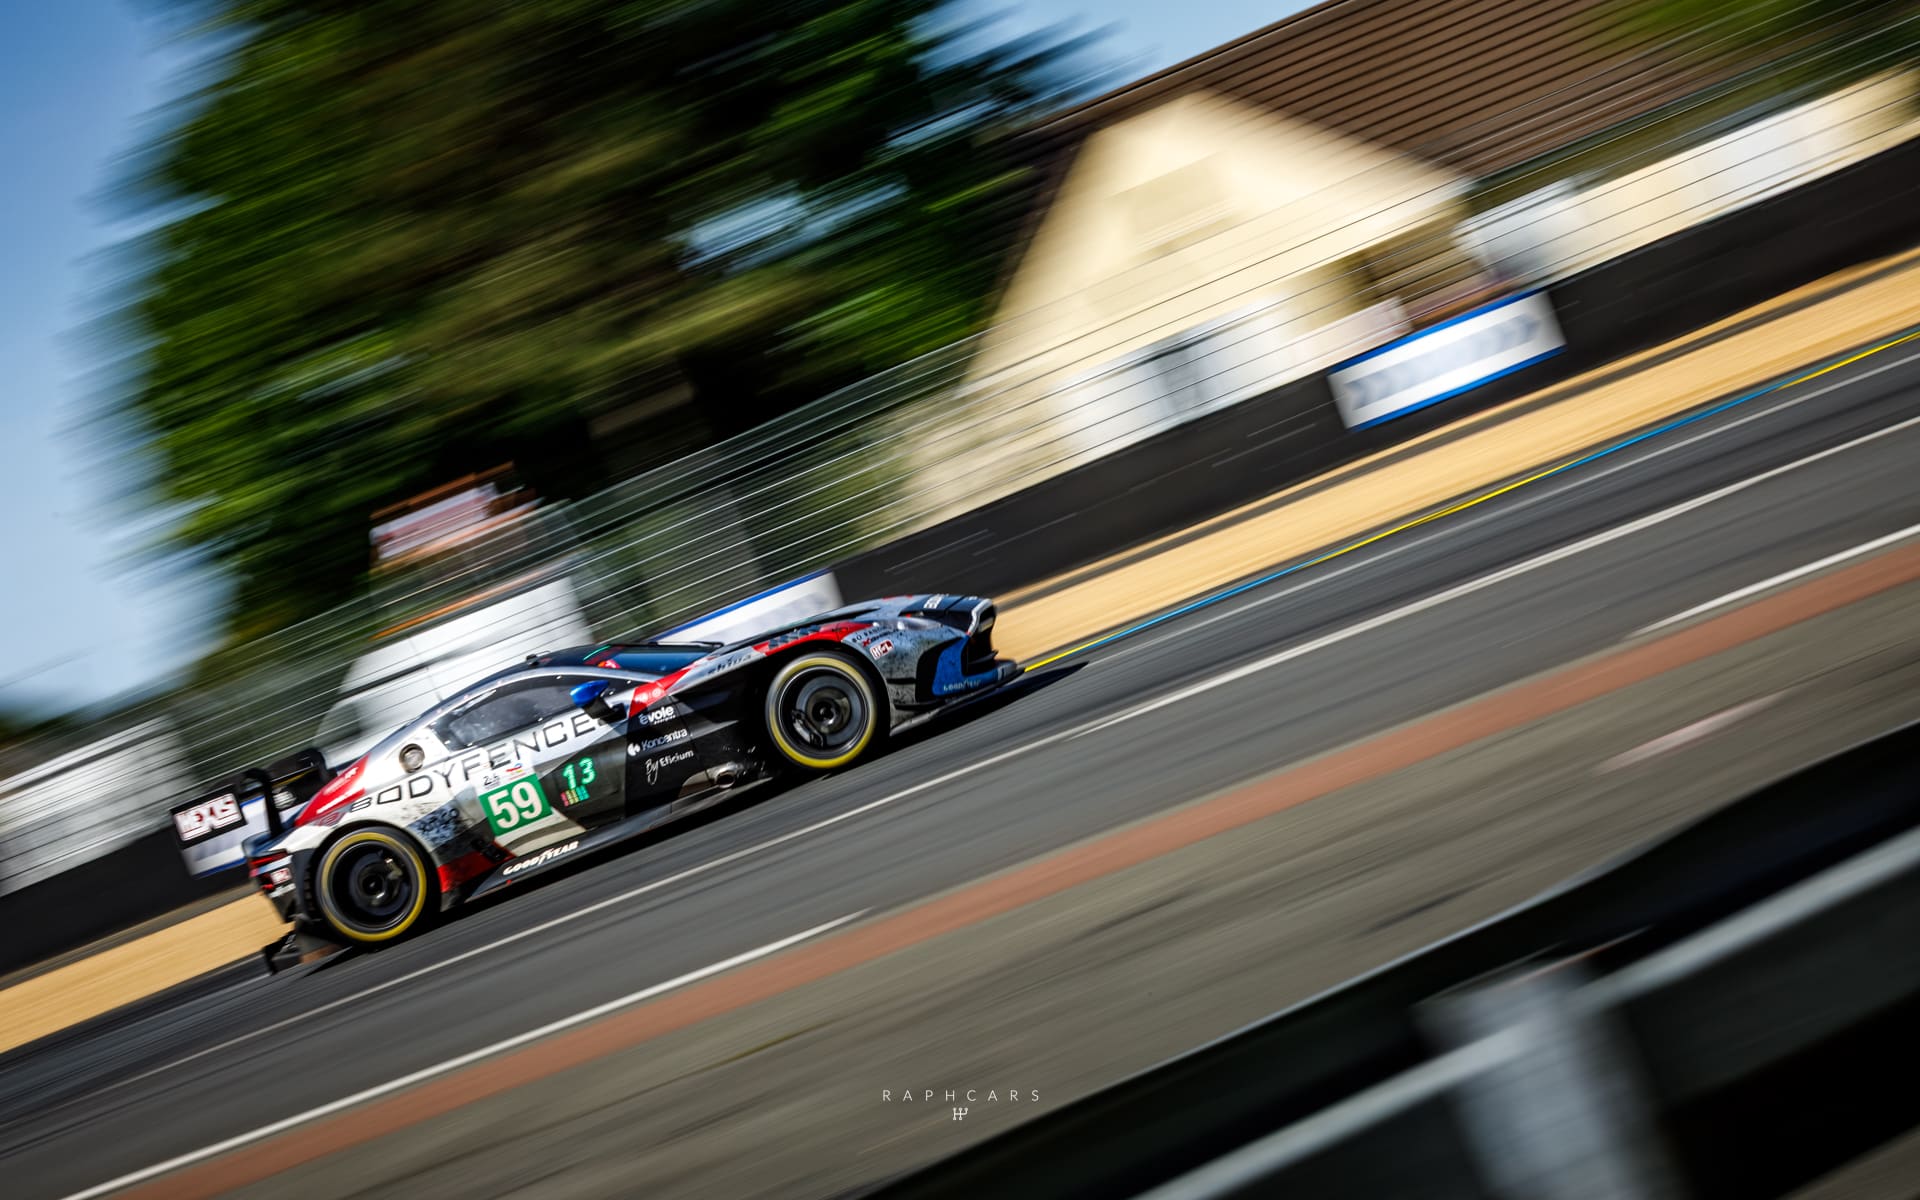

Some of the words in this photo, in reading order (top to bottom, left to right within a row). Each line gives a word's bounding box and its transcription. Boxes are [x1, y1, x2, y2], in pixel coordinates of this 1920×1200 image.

[350, 712, 598, 813] BODYFENCE
[562, 757, 596, 790] 13
[487, 781, 543, 829] 59
[502, 840, 579, 875] GOODYEAR
